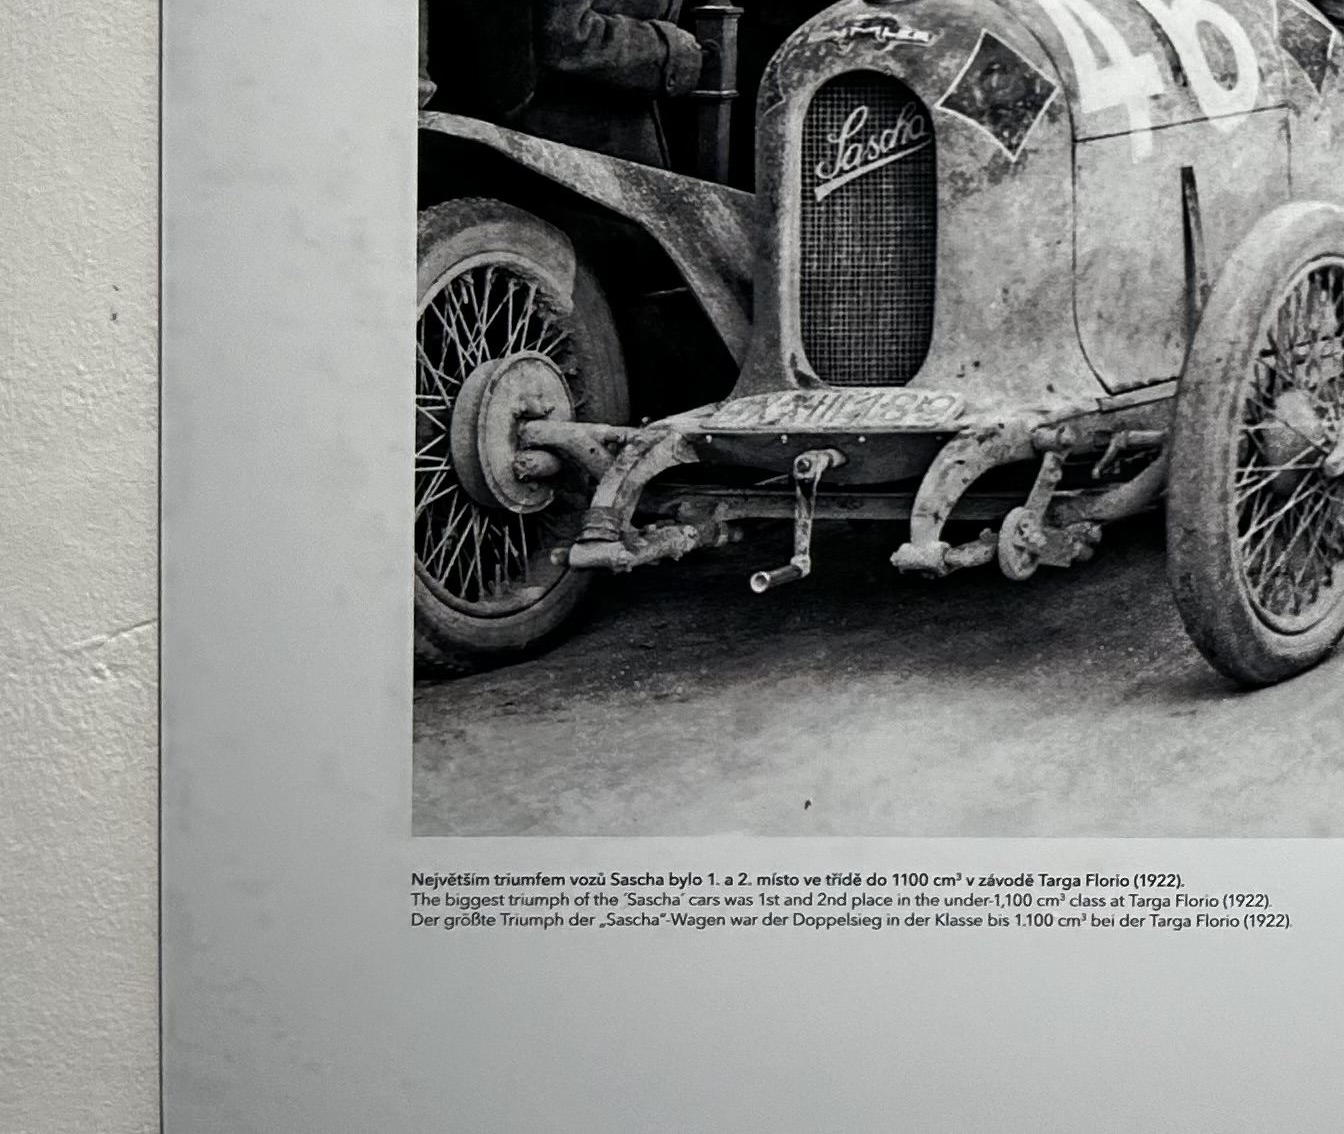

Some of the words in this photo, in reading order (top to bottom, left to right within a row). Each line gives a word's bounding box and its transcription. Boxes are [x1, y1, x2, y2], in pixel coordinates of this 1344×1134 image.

[816, 102, 928, 180] Sascha
[412, 872, 490, 890] Největším
[494, 872, 565, 887] triumfem
[570, 872, 605, 887] vozů
[611, 872, 664, 887] Sascha
[669, 872, 703, 890] bylo
[707, 873, 721, 886] 1.
[724, 876, 734, 887] a
[738, 873, 753, 886] 2.
[757, 872, 800, 886] místo
[803, 876, 821, 887] ve
[825, 872, 861, 887] třídě
[866, 872, 887, 887] do
[892, 873, 928, 887] 1100
[966, 877, 975, 887] v
[978, 873, 1034, 887] závodě
[1038, 874, 1081, 891] Targa
[1086, 873, 1129, 888] Florio
[1134, 873, 1185, 890] (1922).
[410, 892, 440, 907] The
[445, 892, 505, 910] biggest
[508, 892, 569, 910] triumph
[574, 892, 590, 907] of
[593, 892, 619, 907] the
[689, 896, 720, 907] cars
[724, 896, 753, 907] was
[759, 893, 780, 907] 1st
[784, 892, 812, 907] and
[818, 892, 846, 907] 2nd
[852, 893, 893, 910] place
[898, 893, 910, 907] in
[915, 893, 940, 907] the
[944, 893, 1032, 909] under-1,100
[1070, 893, 1106, 908] class
[1110, 895, 1125, 908] at
[1128, 894, 1171, 911] Targa
[1176, 894, 1219, 908] Florio
[1223, 894, 1272, 911] (1922).
[411, 913, 440, 927] Der
[444, 912, 496, 930] größte
[500, 912, 564, 930] Triumph
[569, 912, 596, 927] der
[730, 916, 758, 927] war
[762, 912, 789, 927] der
[793, 913, 882, 930] Doppelsieg
[887, 913, 900, 927] in
[904, 913, 930, 927] der
[936, 913, 983, 927] Klasse
[988, 913, 1010, 927] bis
[1015, 913, 1054, 928] 1.100
[1091, 913, 1114, 928] bei
[1119, 913, 1146, 928] der
[1149, 914, 1191, 931] Targa
[1197, 913, 1240, 928] Florio
[1244, 914, 1294, 930] (1922).
